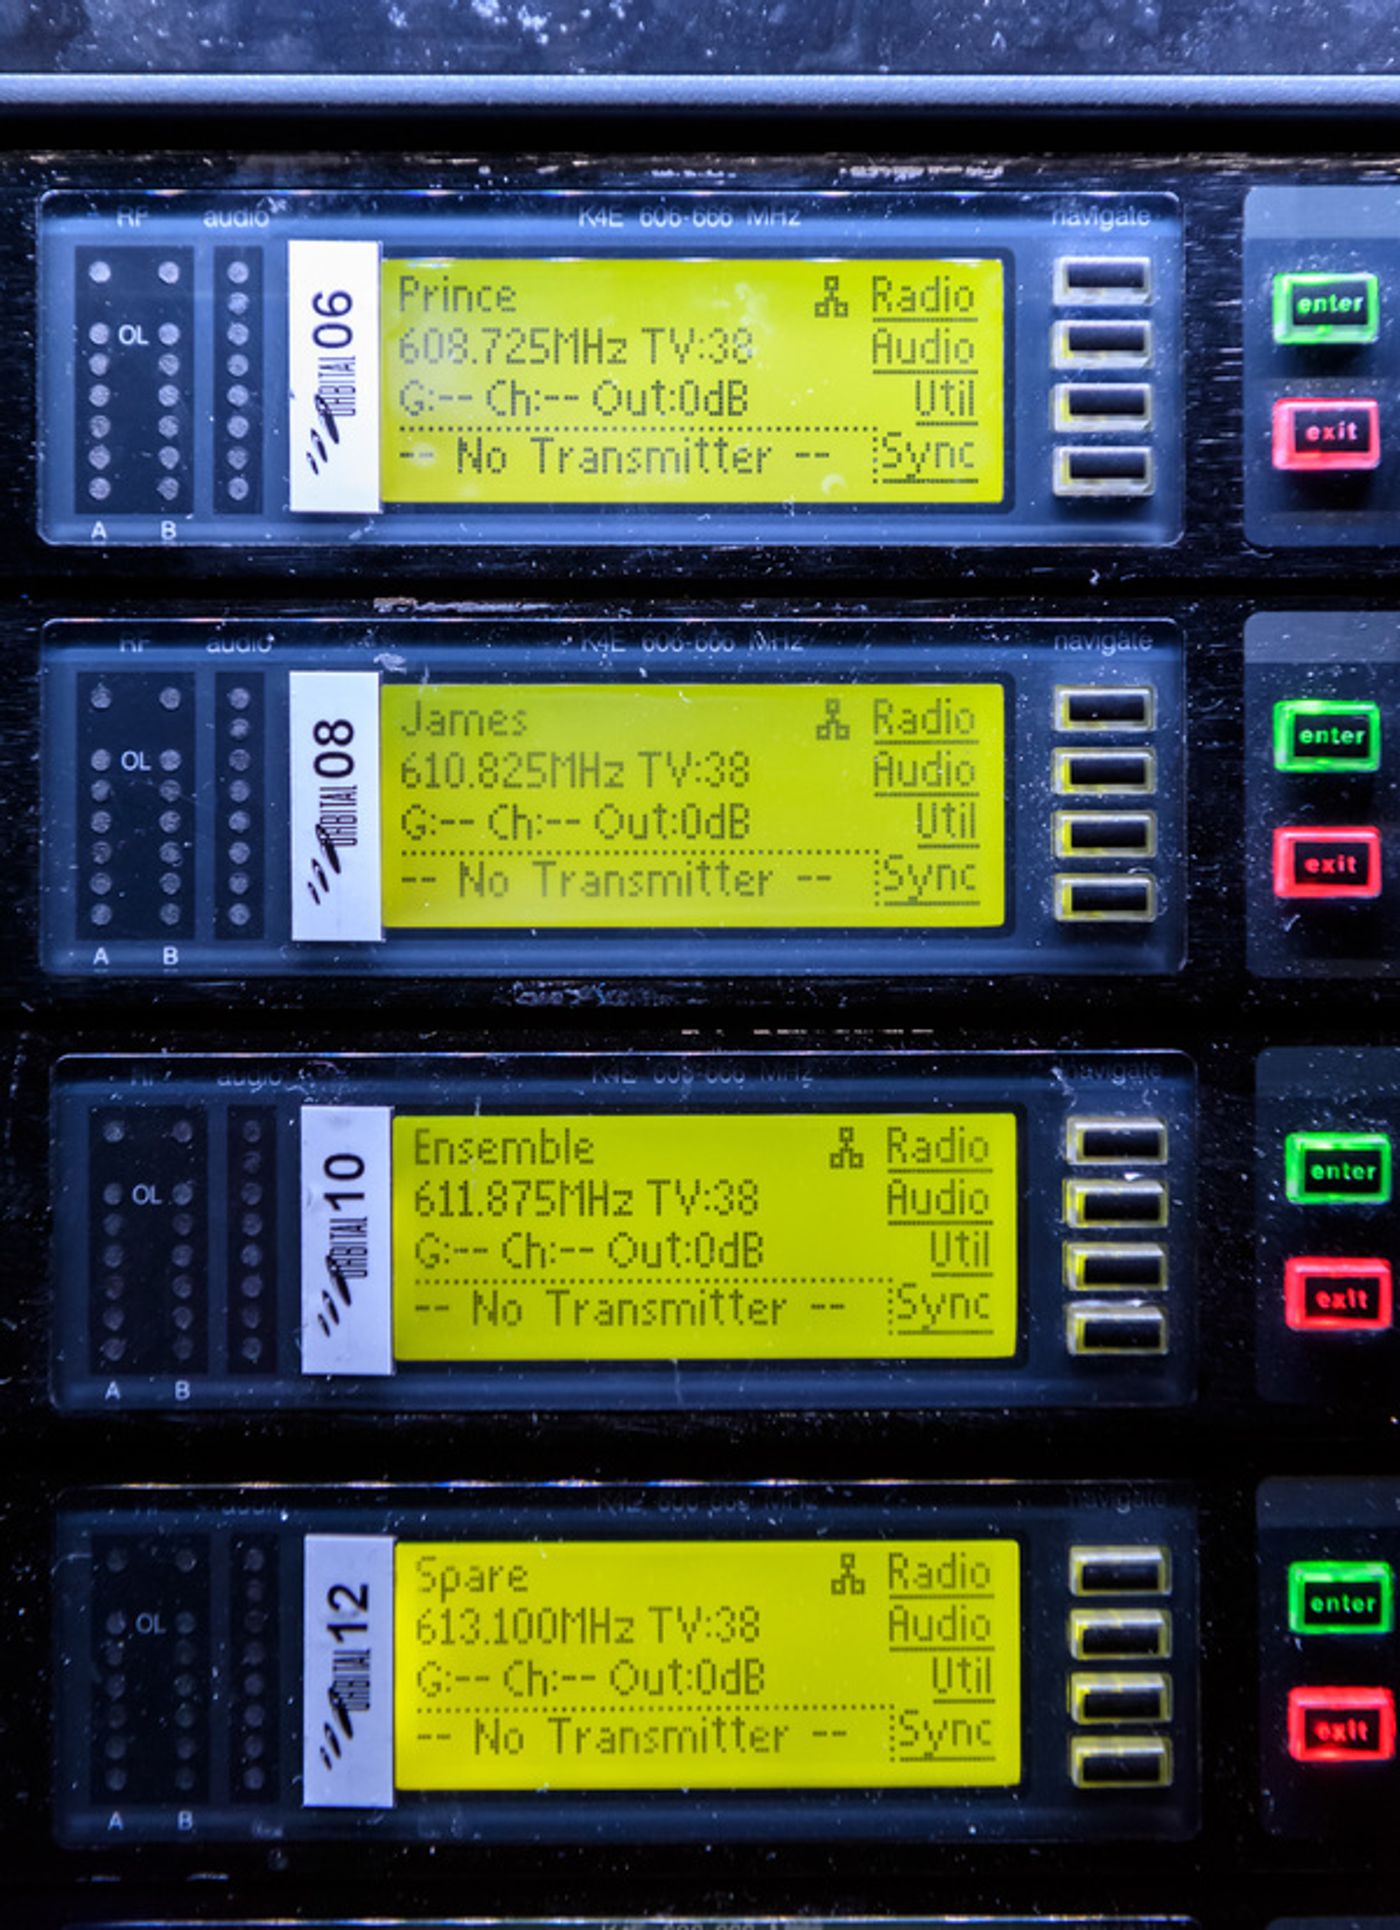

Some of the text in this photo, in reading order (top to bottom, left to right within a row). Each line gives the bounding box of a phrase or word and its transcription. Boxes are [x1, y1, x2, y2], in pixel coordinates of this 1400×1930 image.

[116, 205, 148, 227] RF
[203, 206, 269, 228] audio
[578, 205, 801, 228] K4E 606-666 MHz
[1052, 205, 1151, 231] navigate
[399, 275, 516, 312] Prince
[872, 275, 974, 312] Radio
[1297, 294, 1364, 314] enter
[118, 326, 149, 345] OL
[312, 290, 353, 349] 06
[399, 327, 752, 364] 608.725MHz TV:38
[872, 328, 974, 364] Audio
[916, 380, 974, 416] Util
[1305, 421, 1357, 441] exit
[458, 437, 506, 474] No
[530, 437, 772, 474] Transmitter
[882, 433, 974, 478] Sync
[90, 522, 107, 539] A
[161, 522, 176, 539] B
[206, 632, 271, 653] audio
[749, 629, 804, 652] MHz
[1054, 630, 1153, 656] navigate
[401, 700, 526, 737] James
[873, 699, 974, 735] Radio
[313, 718, 355, 778] 08
[1300, 727, 1366, 747] enter
[121, 752, 151, 772] OL
[401, 751, 749, 789] 610.825MHz TV:38
[874, 751, 975, 787] Audio
[917, 803, 975, 839] Util
[459, 861, 508, 897] No
[532, 860, 773, 897] Transmitter
[884, 855, 976, 901] Sync
[1304, 855, 1357, 875] exit
[93, 948, 109, 965] A
[163, 947, 179, 965] B
[414, 1128, 594, 1165] Ensemble
[887, 1126, 988, 1163] Radio
[324, 1153, 365, 1211] 10
[1311, 1163, 1377, 1183] enter
[132, 1185, 162, 1206] OL
[415, 1179, 758, 1217] 611.875MHz TV:38
[887, 1179, 988, 1215] Audio
[931, 1231, 989, 1267] Util
[473, 1290, 522, 1326] No
[546, 1289, 787, 1326] Transmitter
[897, 1283, 989, 1330] Sync
[1316, 1288, 1369, 1311] exit
[104, 1382, 121, 1400] A
[174, 1382, 191, 1400] B
[417, 1556, 528, 1601] Spare
[888, 1553, 990, 1589] Radio
[328, 1584, 369, 1643] 12
[1311, 1595, 1377, 1615] enter
[135, 1615, 166, 1634] OL
[418, 1607, 759, 1645] 613.100MHz TV:38
[889, 1605, 990, 1642] Audio
[933, 1657, 991, 1694] Util
[475, 1718, 523, 1755] No
[548, 1716, 789, 1753] Transmitter
[899, 1710, 991, 1758] Sync
[1314, 1720, 1369, 1742] exit
[107, 1812, 124, 1830] A
[177, 1812, 194, 1830] B
